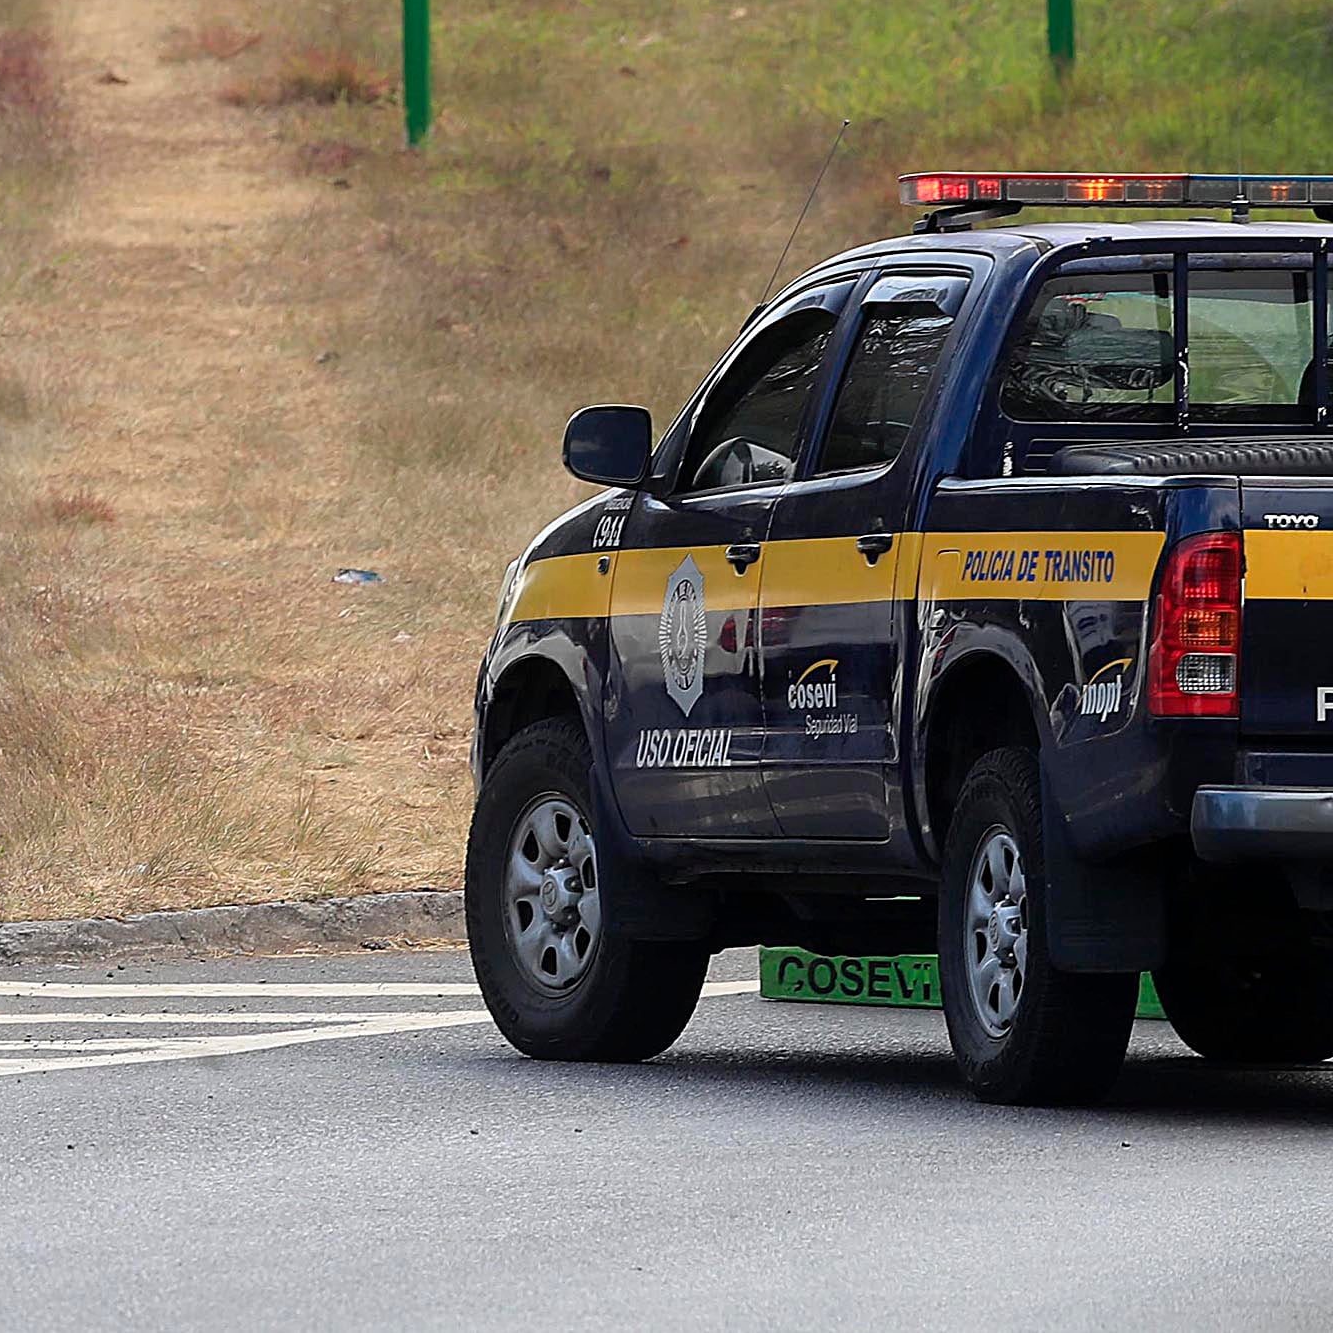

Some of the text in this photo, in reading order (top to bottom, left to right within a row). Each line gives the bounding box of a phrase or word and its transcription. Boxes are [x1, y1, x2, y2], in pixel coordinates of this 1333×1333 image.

[961, 550, 1115, 583] POLICIA DE TRANSITO
[787, 673, 837, 709] cosevi
[804, 713, 843, 741] Seguridad
[635, 728, 733, 768] USO OFICIAL
